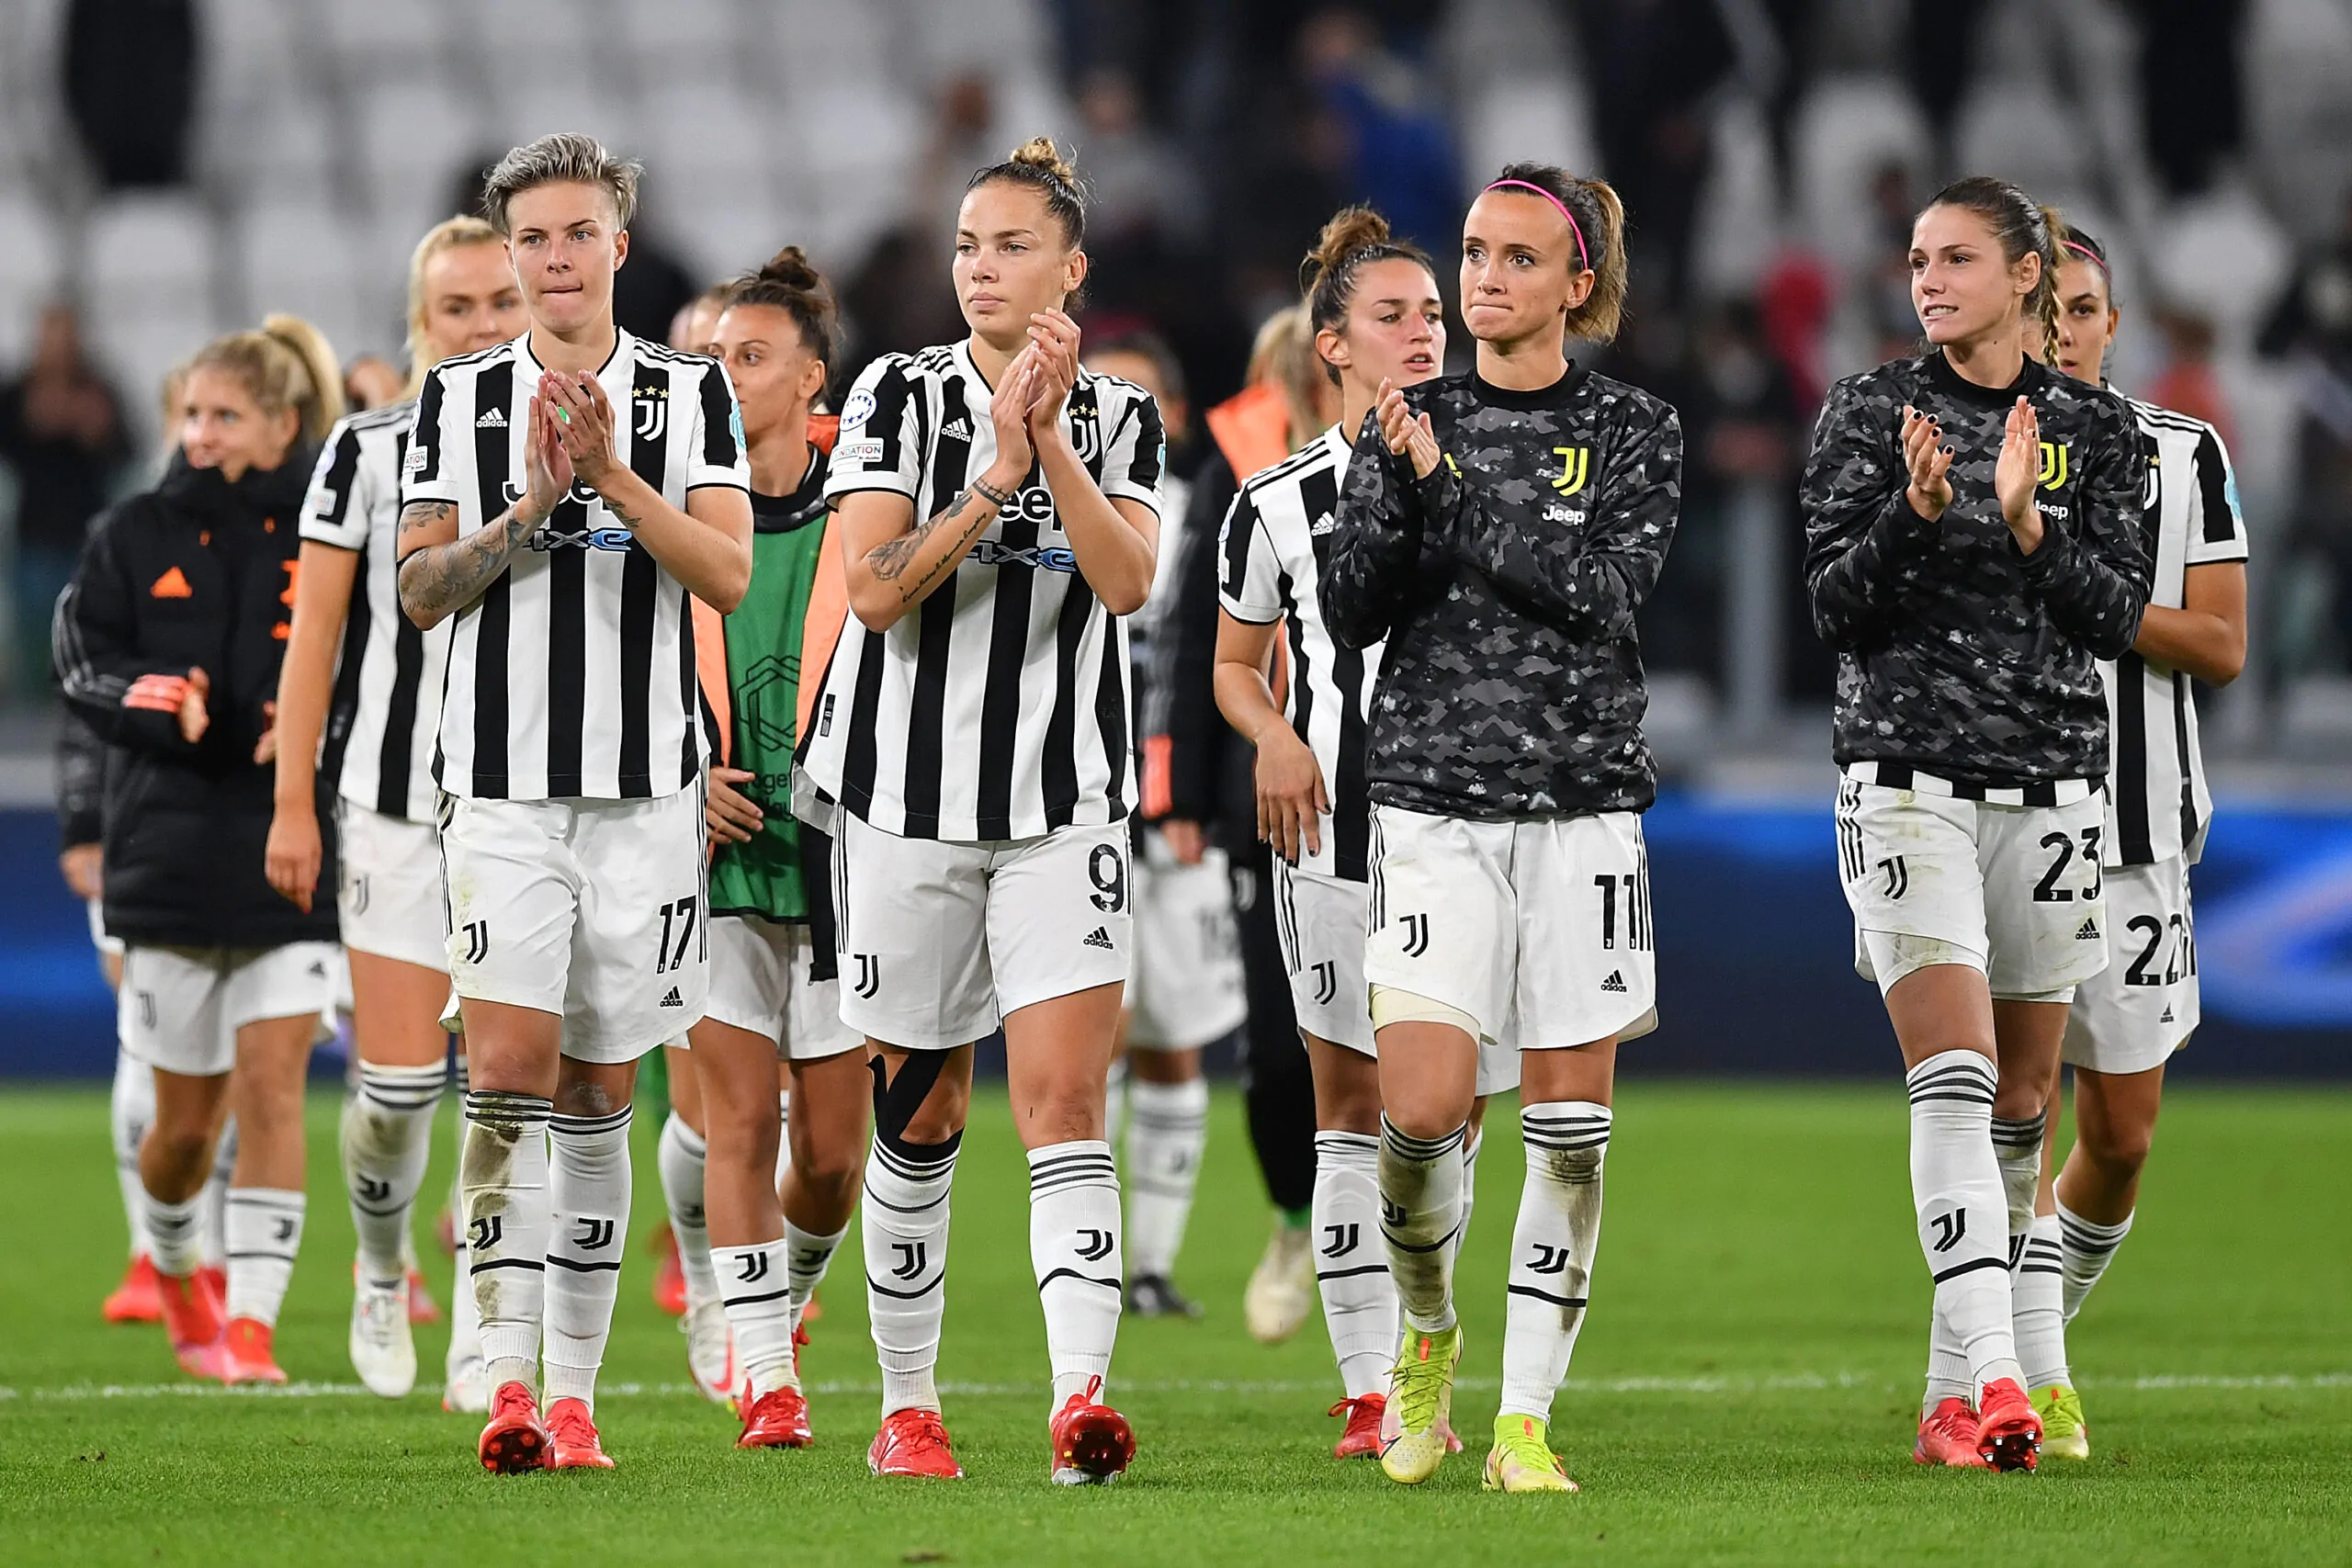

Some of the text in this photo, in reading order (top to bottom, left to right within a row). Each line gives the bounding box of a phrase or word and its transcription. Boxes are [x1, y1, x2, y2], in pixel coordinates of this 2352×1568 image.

[476, 419, 508, 428] adidas
[941, 426, 972, 443] adidas
[1542, 505, 1587, 525] Jeep
[2032, 825, 2101, 903] 23
[1089, 843, 1125, 914] 9
[1593, 874, 1637, 950] 11
[656, 894, 696, 975] 17
[2075, 931, 2100, 941] adidas
[1082, 938, 1114, 950] adidas
[1600, 984, 1627, 993] adidas
[660, 999, 684, 1008] adidas
